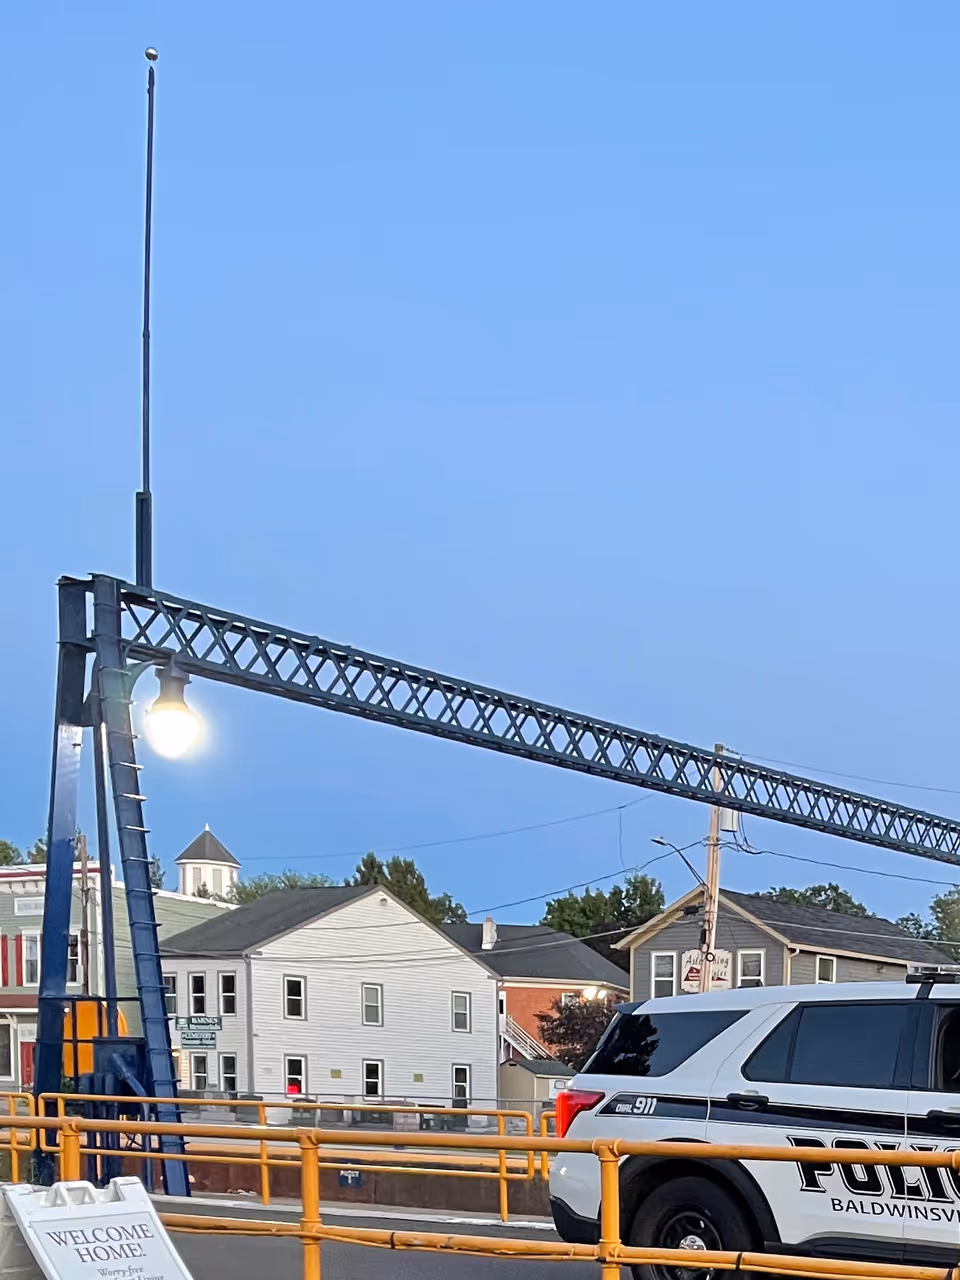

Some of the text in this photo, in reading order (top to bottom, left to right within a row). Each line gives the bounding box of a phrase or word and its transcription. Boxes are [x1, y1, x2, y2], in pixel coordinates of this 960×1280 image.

[685, 952, 729, 968] Asthing
[633, 1097, 657, 1115] 911
[45, 1223, 154, 1247] WELCOME
[74, 1242, 147, 1263] HOME!
[97, 1265, 144, 1277] Worry-free
